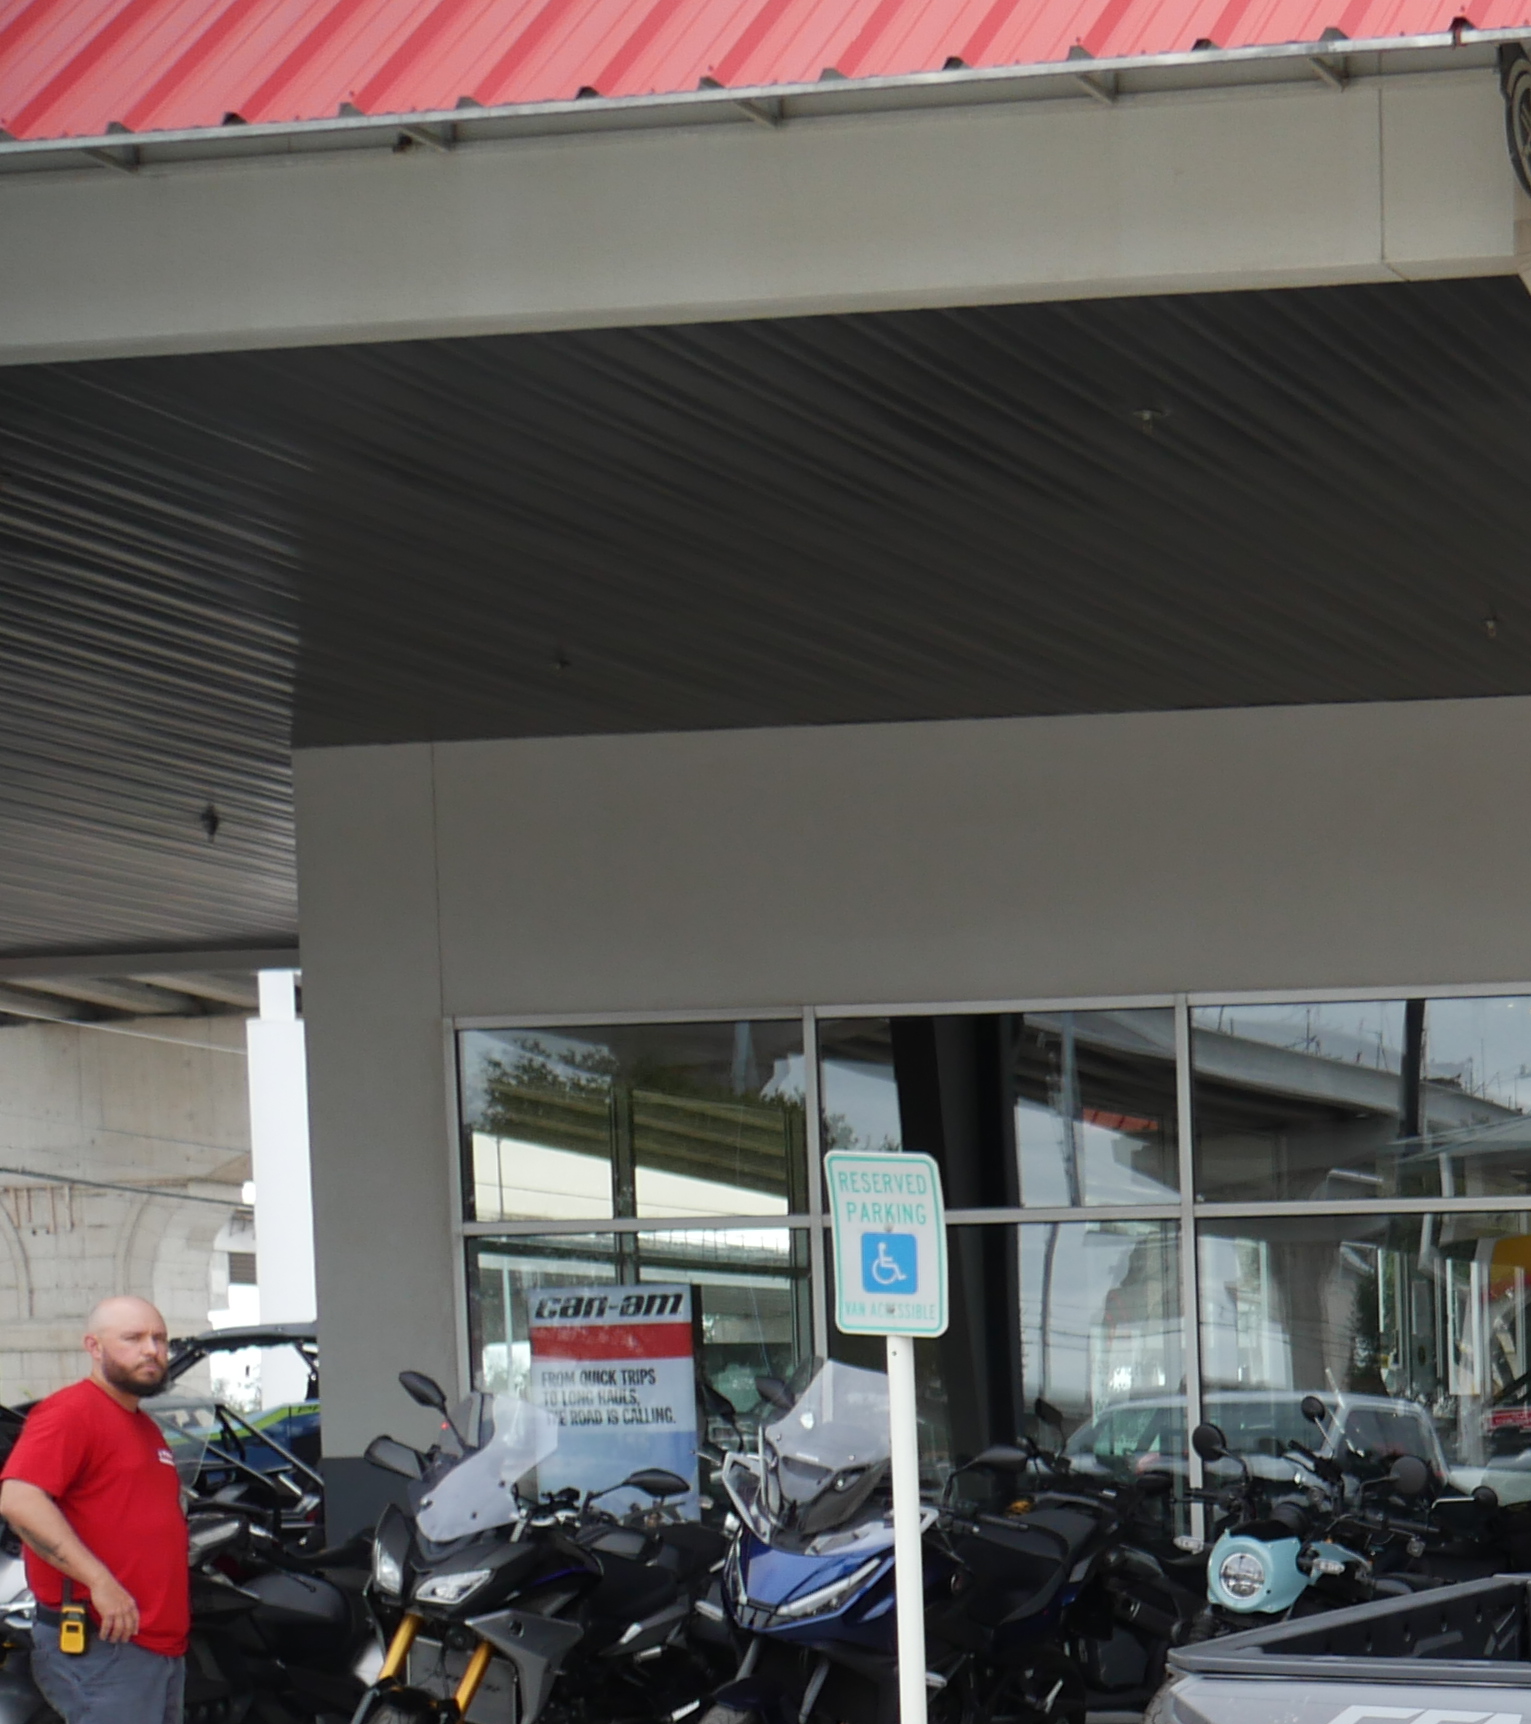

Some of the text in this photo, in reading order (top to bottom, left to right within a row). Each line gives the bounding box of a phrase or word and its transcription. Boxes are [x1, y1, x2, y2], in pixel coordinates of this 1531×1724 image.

[838, 1171, 927, 1195] RESERVED
[846, 1202, 927, 1225] PARKING
[845, 1302, 866, 1316] VAN
[541, 1369, 656, 1387] FROM QUICK TRIPS
[544, 1391, 558, 1407] TO
[562, 1390, 594, 1407] LONG
[571, 1409, 603, 1426] ROAD
[607, 1409, 619, 1425] IS
[622, 1407, 676, 1425] CALLING.
